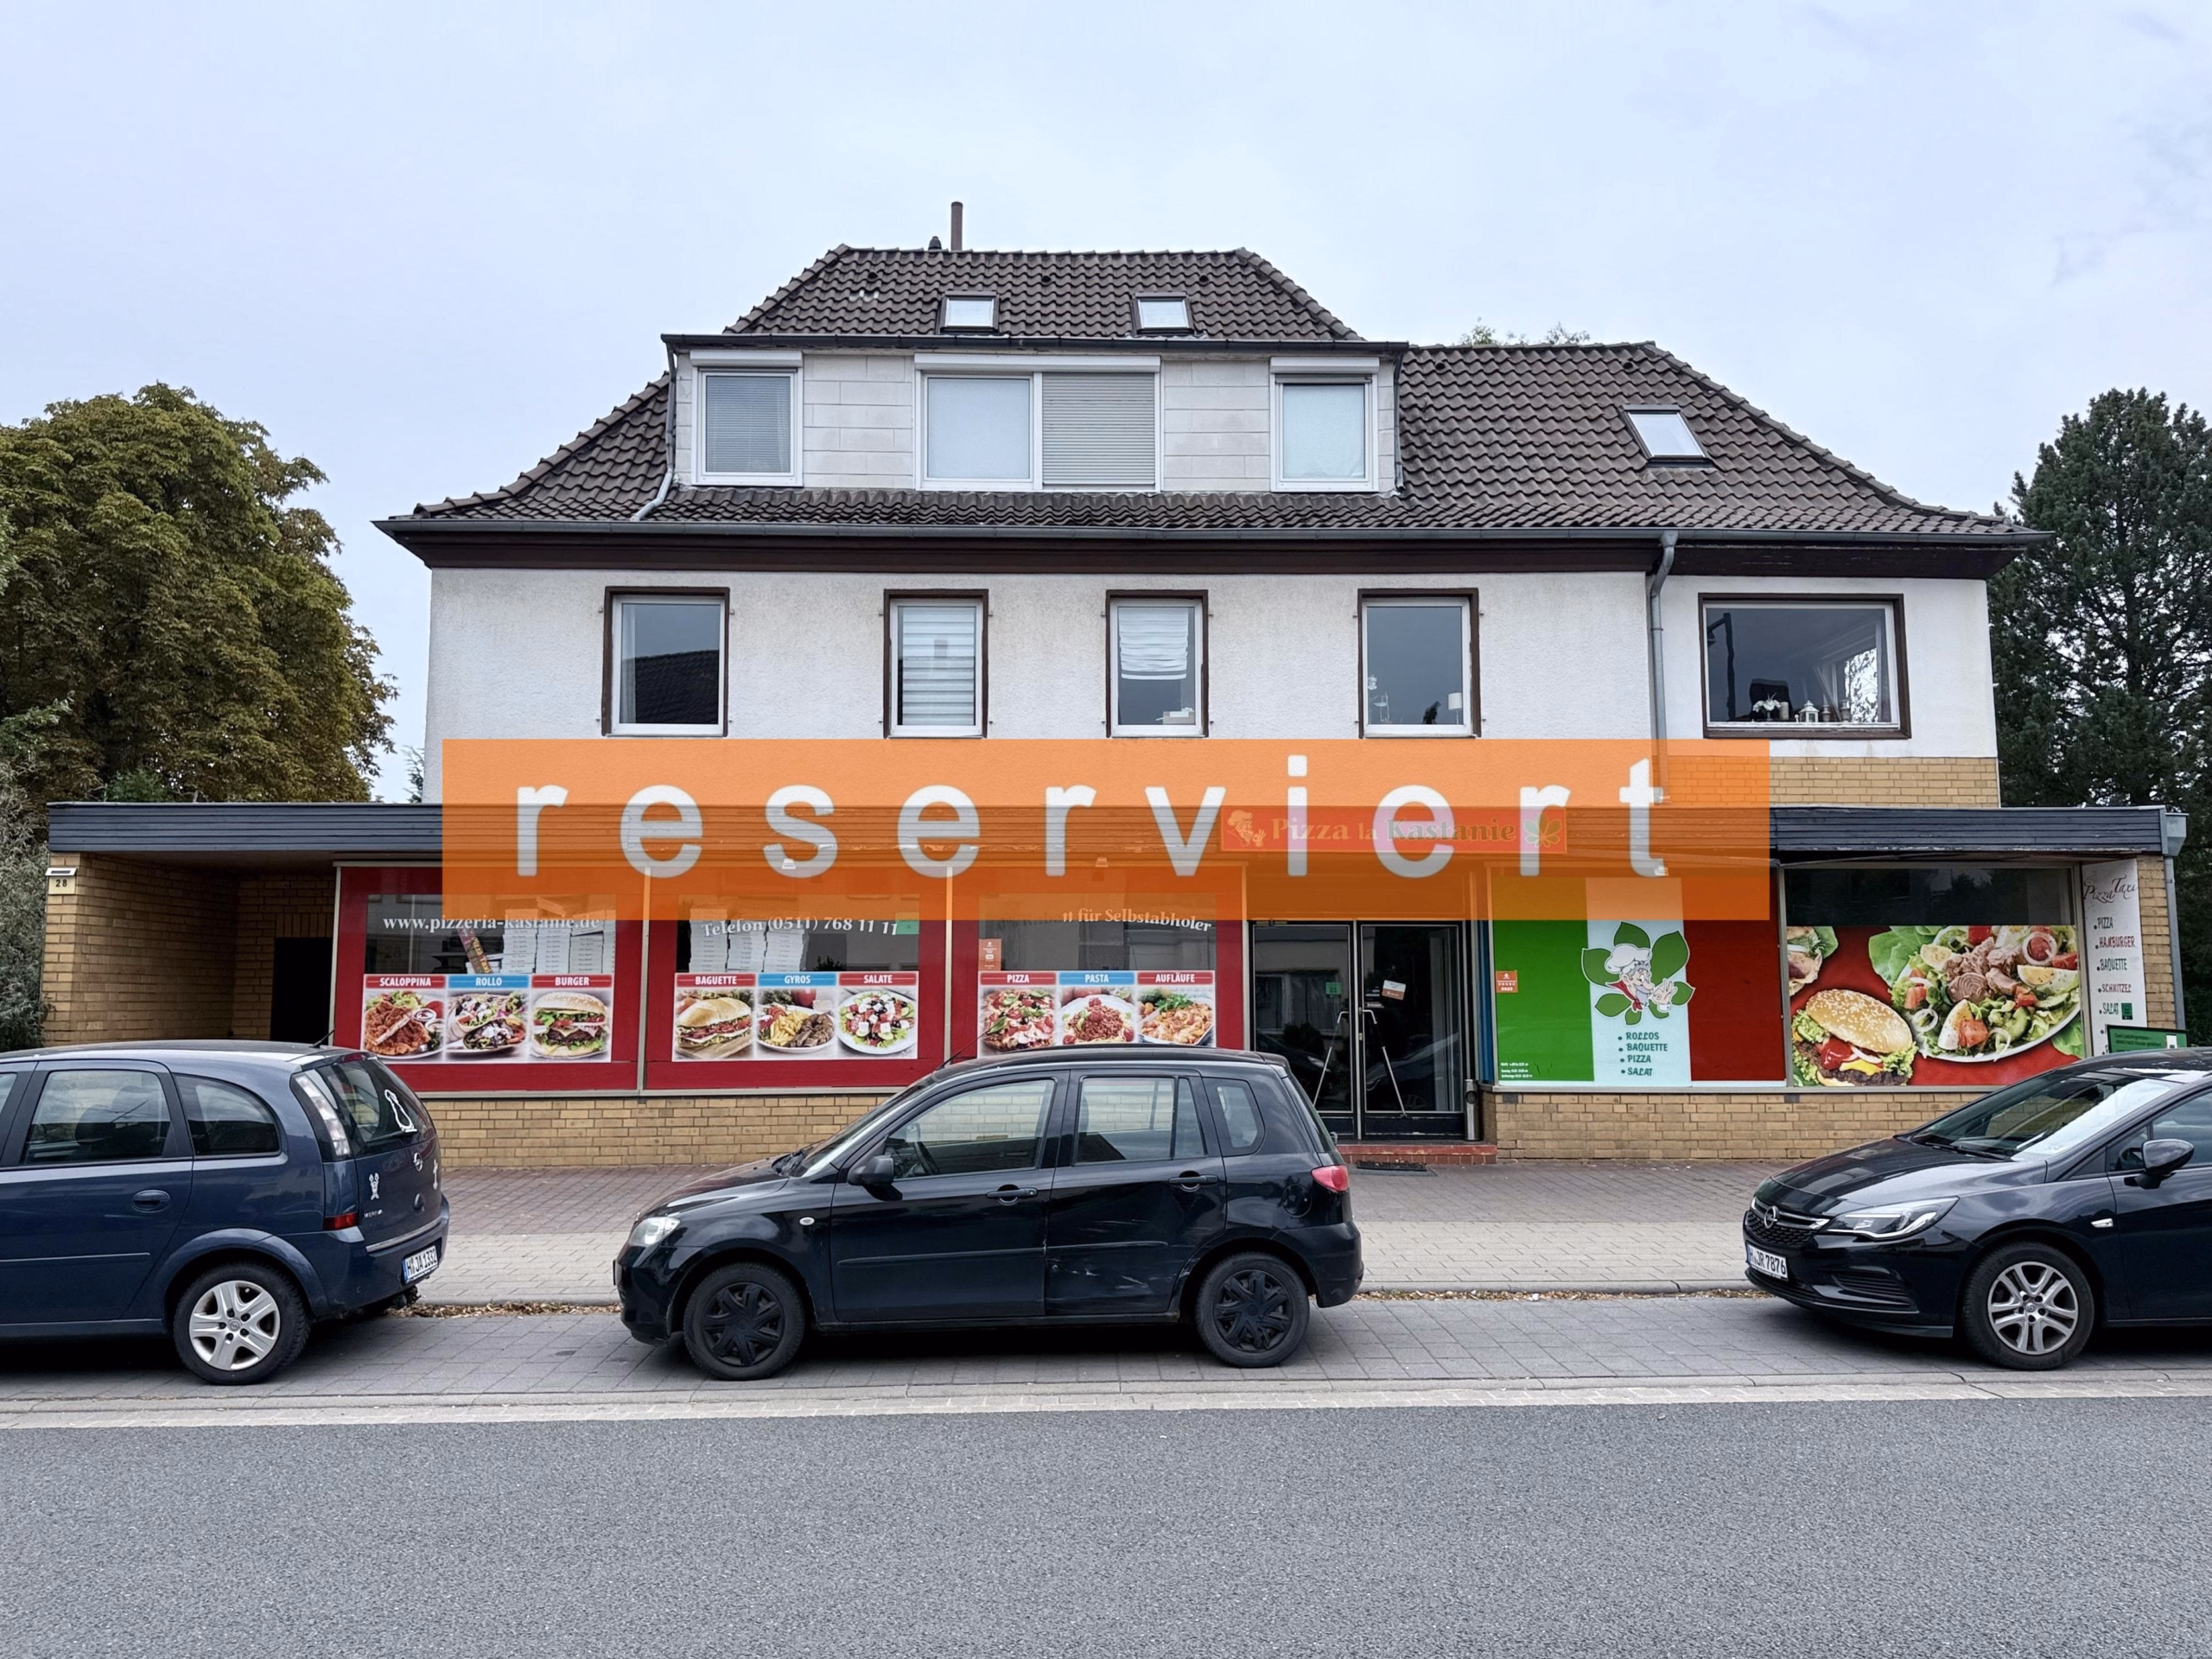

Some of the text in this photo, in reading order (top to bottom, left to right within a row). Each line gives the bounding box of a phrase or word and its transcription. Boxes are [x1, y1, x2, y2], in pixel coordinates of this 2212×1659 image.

[1271, 817, 1516, 842] Pizza la Kastanie
[55, 879, 67, 887] 28
[2083, 874, 2138, 904] Pizza Taxi
[383, 914, 600, 933] www.pizzeria-kastanie.de
[1078, 907, 1102, 922] für
[1105, 908, 1211, 932] Selbstabholer
[2097, 917, 2113, 930] PIZZA
[702, 915, 898, 937] Telefon (0511) 768 11 11
[2099, 935, 2135, 948] HAMBURGER
[379, 977, 432, 987] SCALOPPINA
[475, 976, 502, 987] ROLLO
[555, 976, 590, 987] BURGER
[695, 976, 737, 985] BAGUETTE
[784, 975, 810, 984] GYROS
[864, 974, 893, 983] SALATE
[1007, 974, 1030, 983] PIZZA
[1084, 973, 1109, 983] PASTA
[1155, 971, 1195, 983] AUFLÄUFE
[2101, 983, 2132, 994] SCHNITZEL
[2102, 1002, 2119, 1015] SALAT
[1625, 1032, 1660, 1040] ROLLOS
[1627, 1054, 1651, 1063] PIZZA
[1627, 1067, 1653, 1076] SALAT
[1765, 1255, 1786, 1275] 7876
